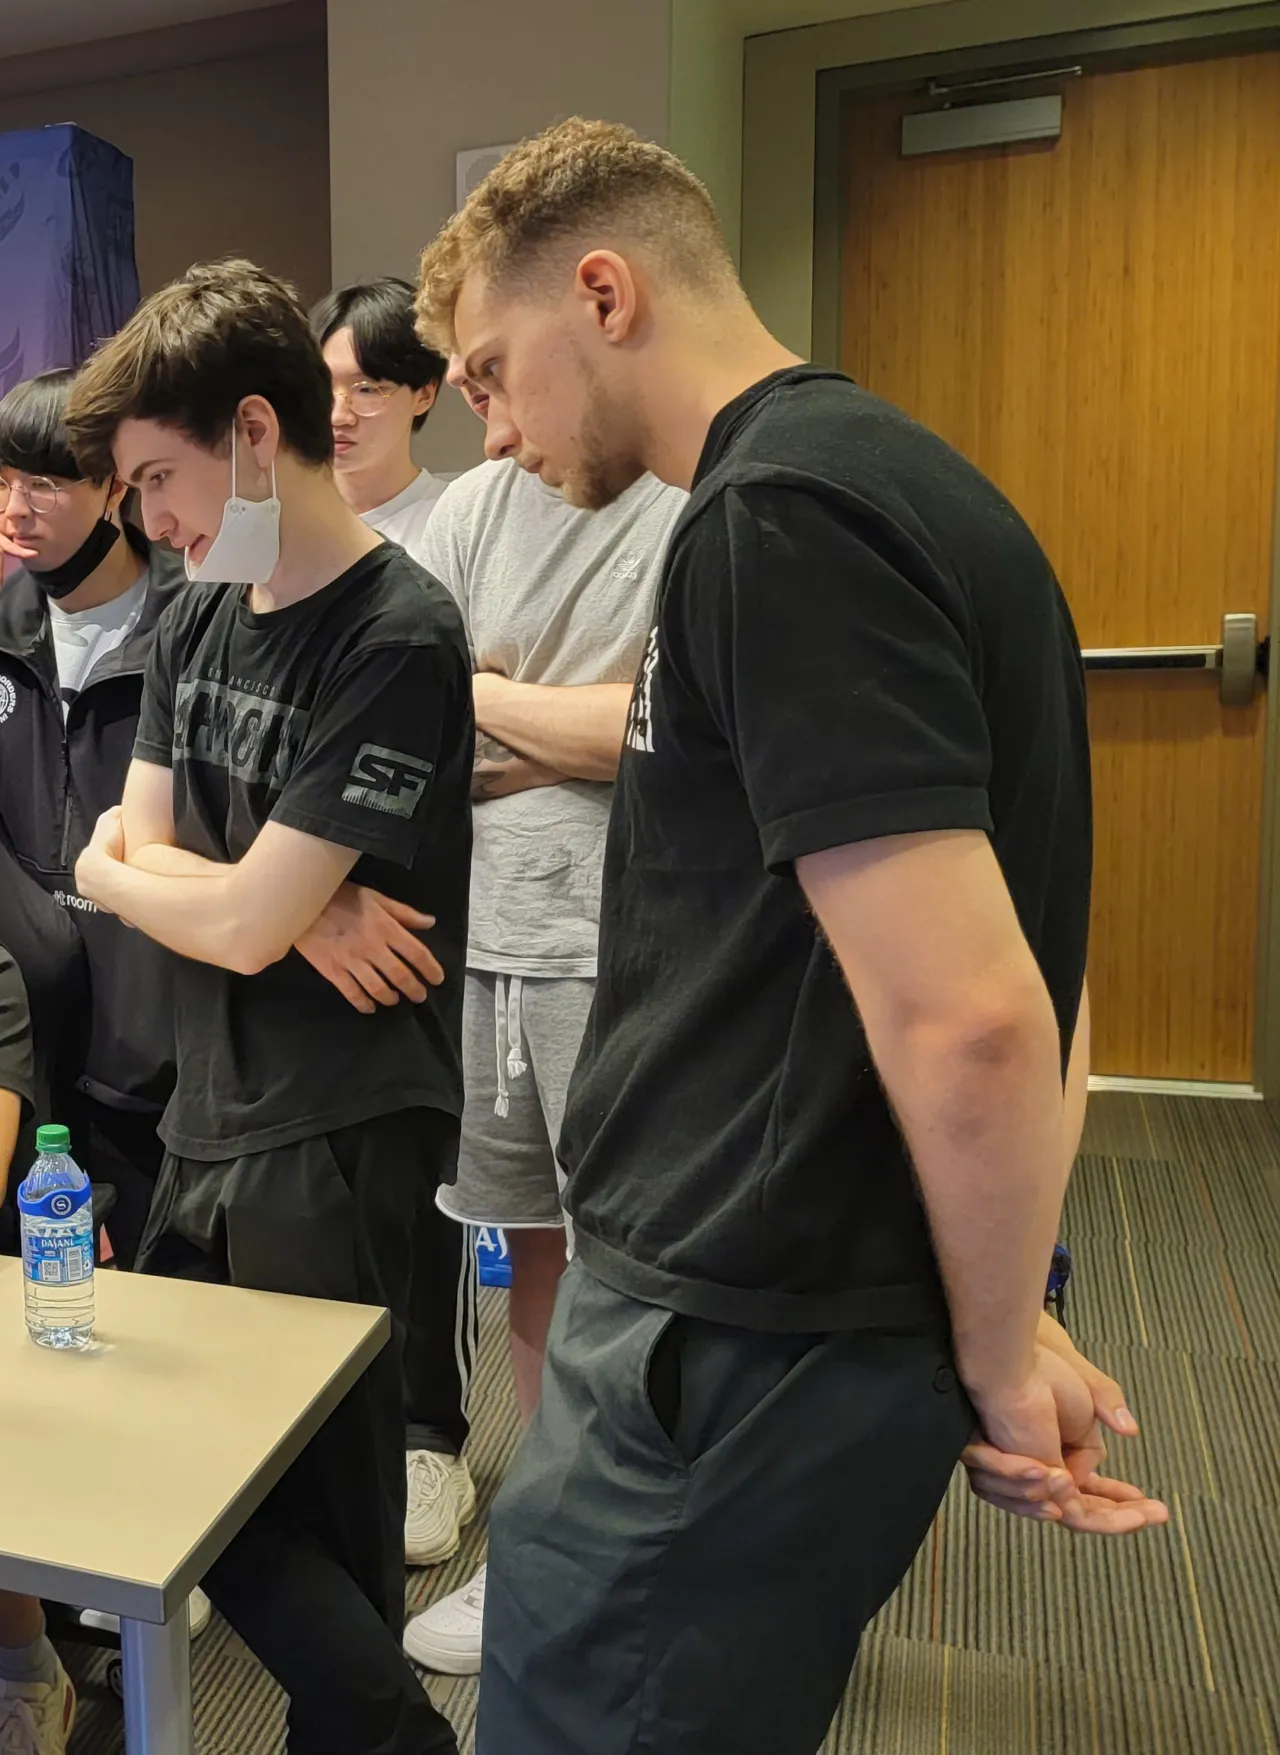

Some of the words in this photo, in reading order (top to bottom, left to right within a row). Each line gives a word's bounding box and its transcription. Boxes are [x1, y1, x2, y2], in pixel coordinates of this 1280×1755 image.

[345, 753, 433, 797] SF
[66, 894, 97, 913] room
[41, 1238, 74, 1249] DASANI
